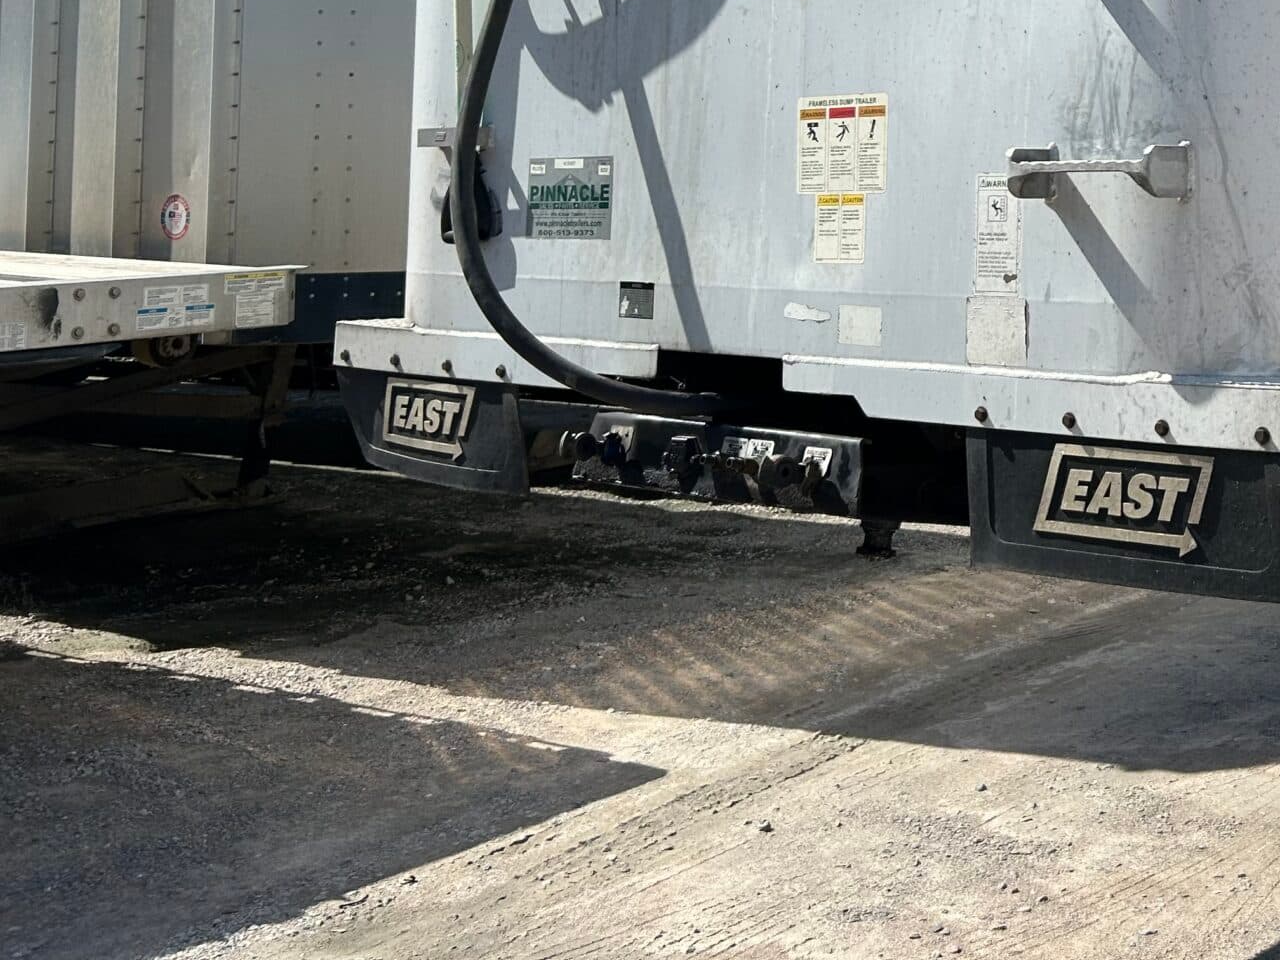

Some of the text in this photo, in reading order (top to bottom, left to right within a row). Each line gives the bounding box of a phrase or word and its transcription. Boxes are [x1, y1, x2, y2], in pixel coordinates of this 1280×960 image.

[530, 184, 610, 202] PINNACLE
[986, 180, 1008, 188] WARN
[393, 394, 460, 435] EAST
[1060, 468, 1190, 522] EAST
